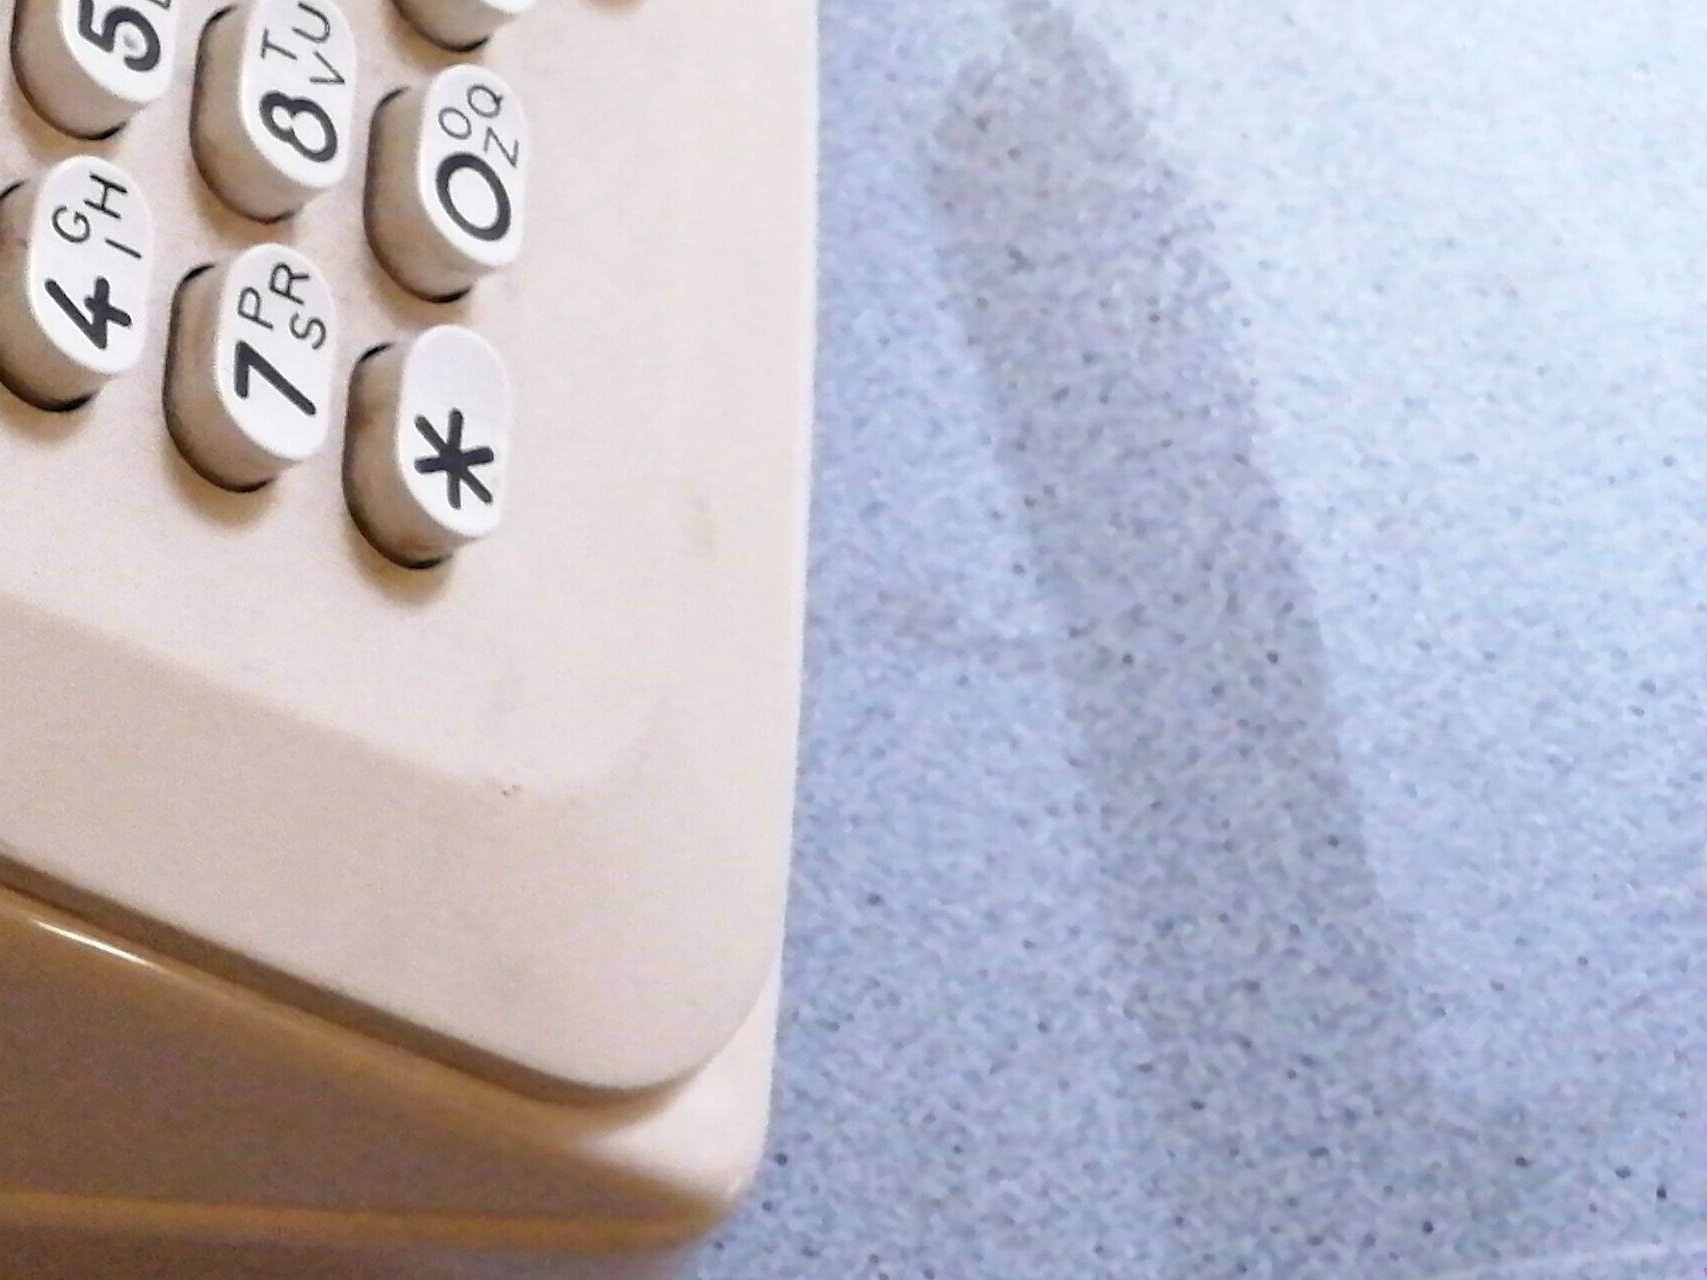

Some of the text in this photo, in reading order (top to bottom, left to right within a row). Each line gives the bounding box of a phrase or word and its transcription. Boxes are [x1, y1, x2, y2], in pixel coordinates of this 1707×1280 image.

[258, 90, 338, 163] 8
[435, 152, 512, 241] 0
[44, 276, 133, 351] 4
[234, 340, 317, 417] 7
